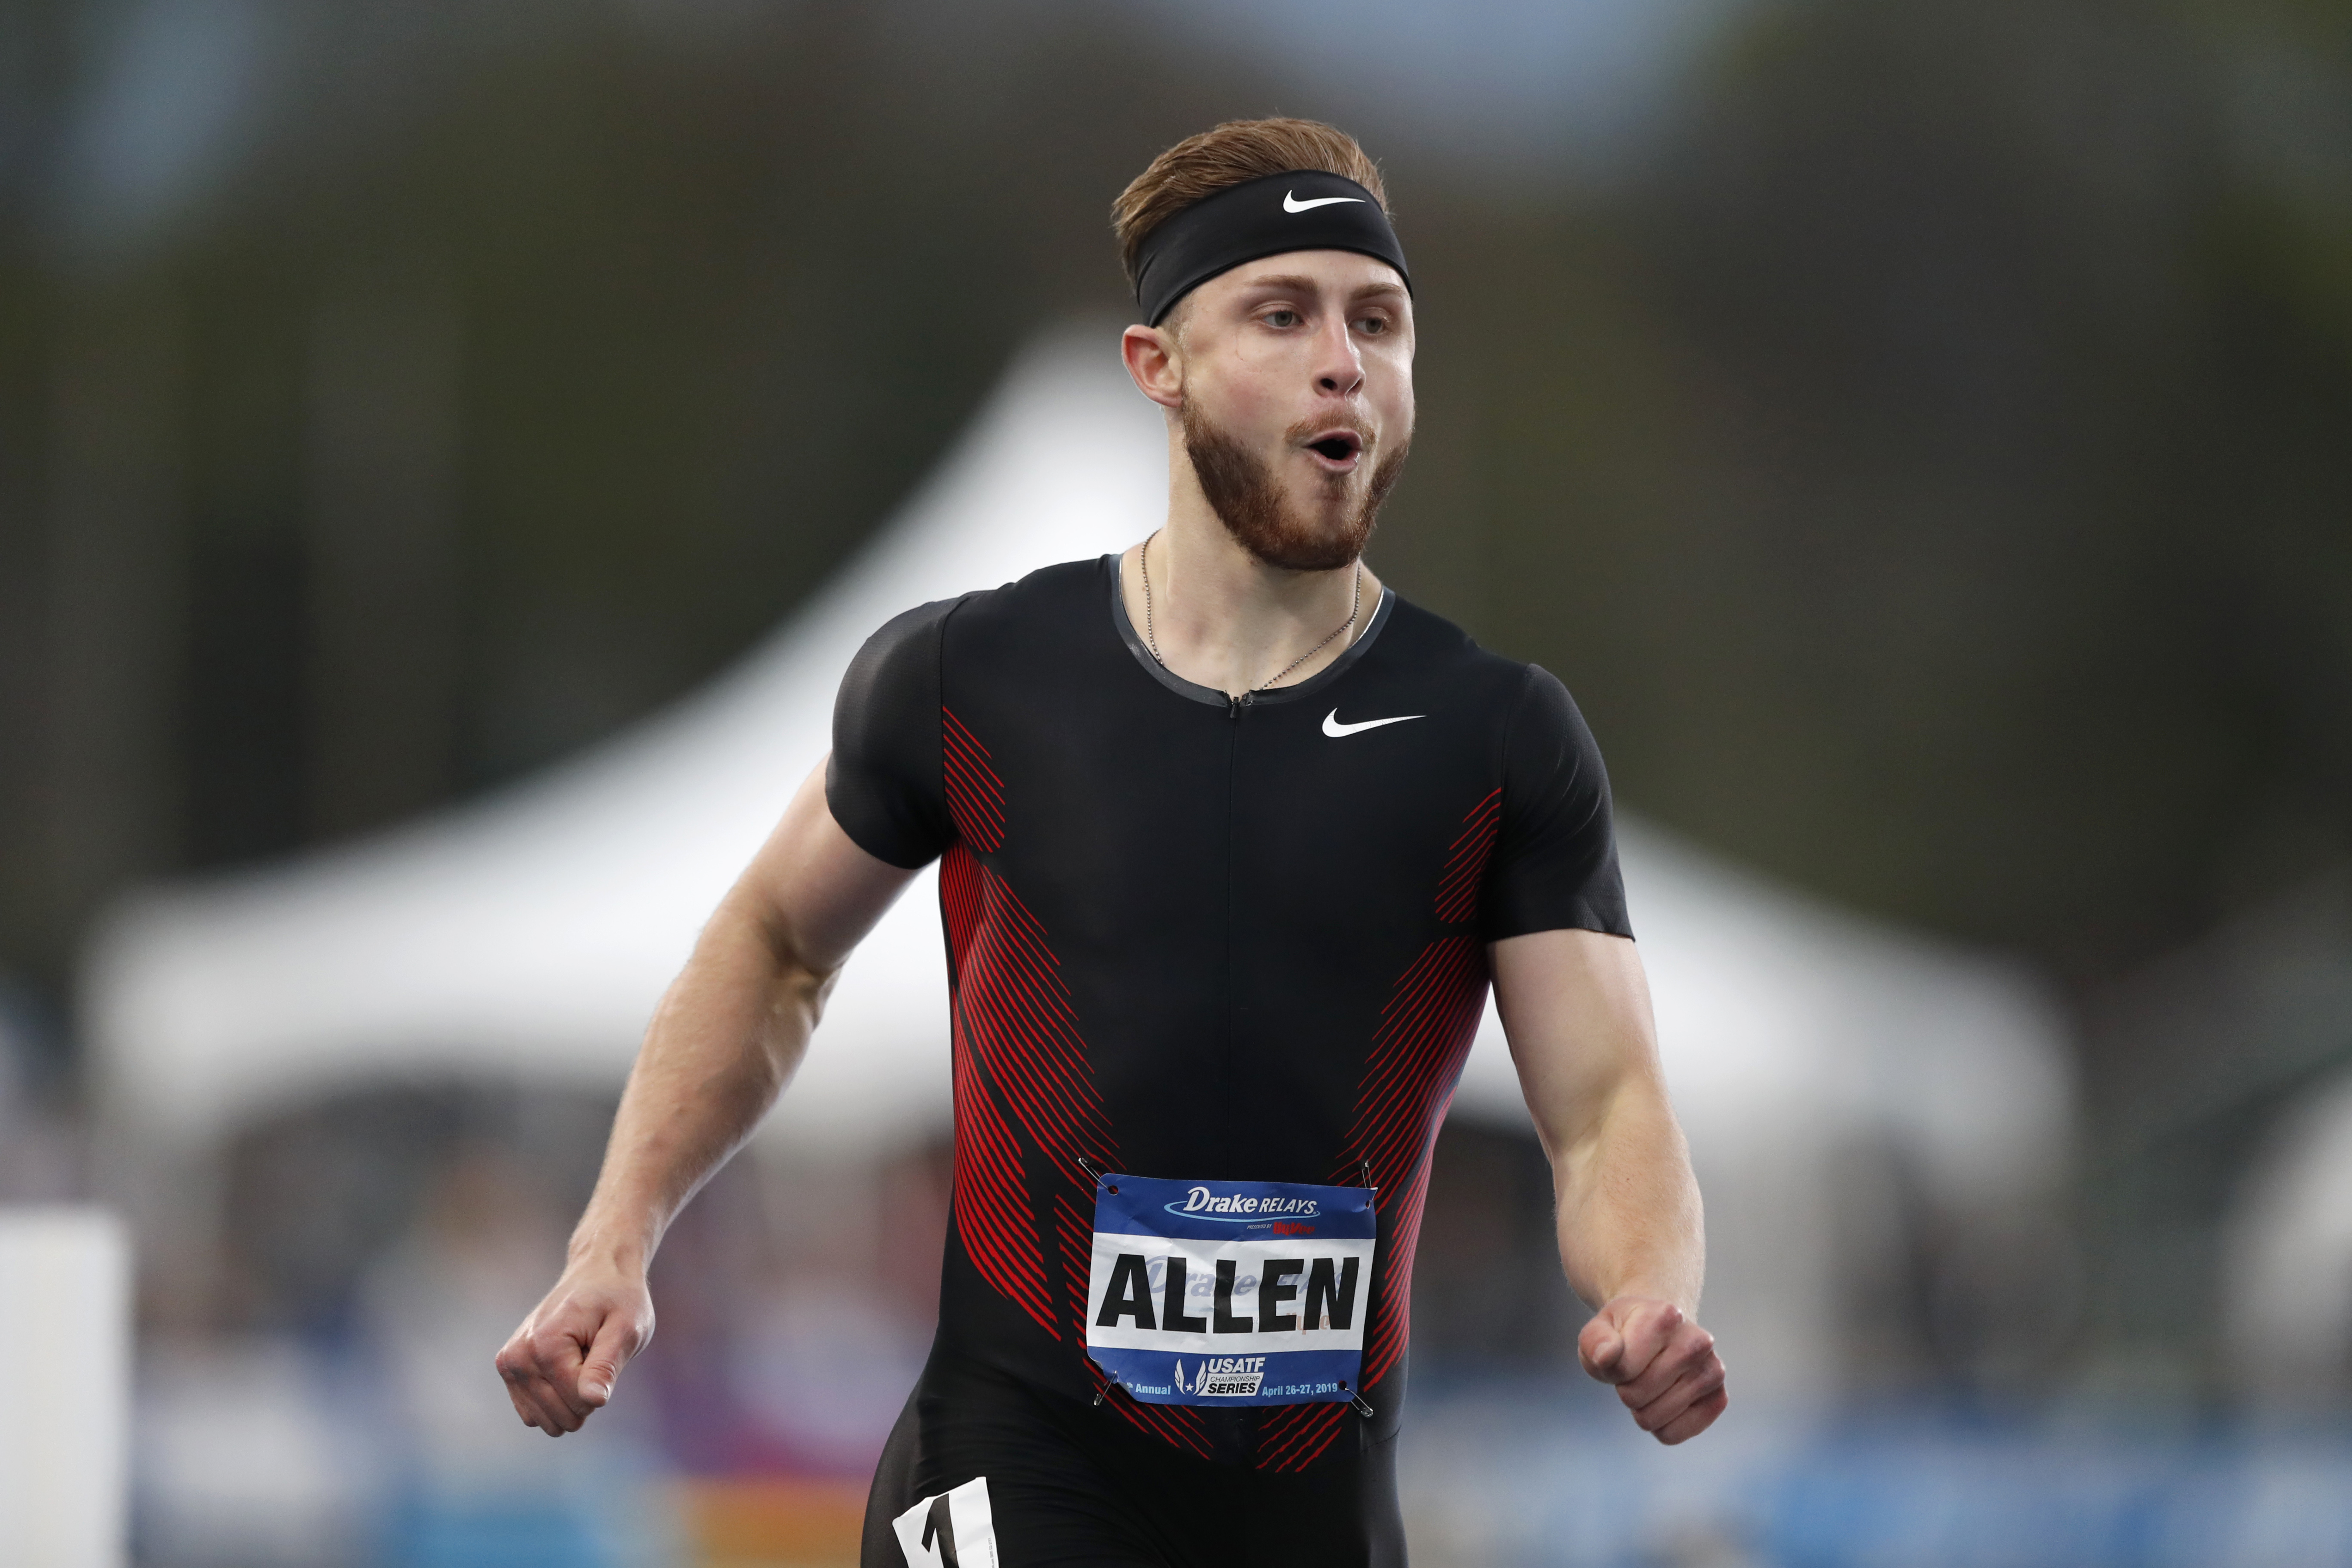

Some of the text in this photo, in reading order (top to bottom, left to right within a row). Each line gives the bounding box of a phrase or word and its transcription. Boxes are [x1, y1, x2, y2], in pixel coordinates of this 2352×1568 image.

[1183, 1186, 1317, 1214] Drake RELAYS
[1095, 1254, 1360, 1333] ALLEN
[1208, 1357, 1265, 1373] USATF
[1135, 1383, 1171, 1395] Annual
[1208, 1383, 1256, 1394] SERIES
[1262, 1383, 1338, 1398] April 26-27, 2019
